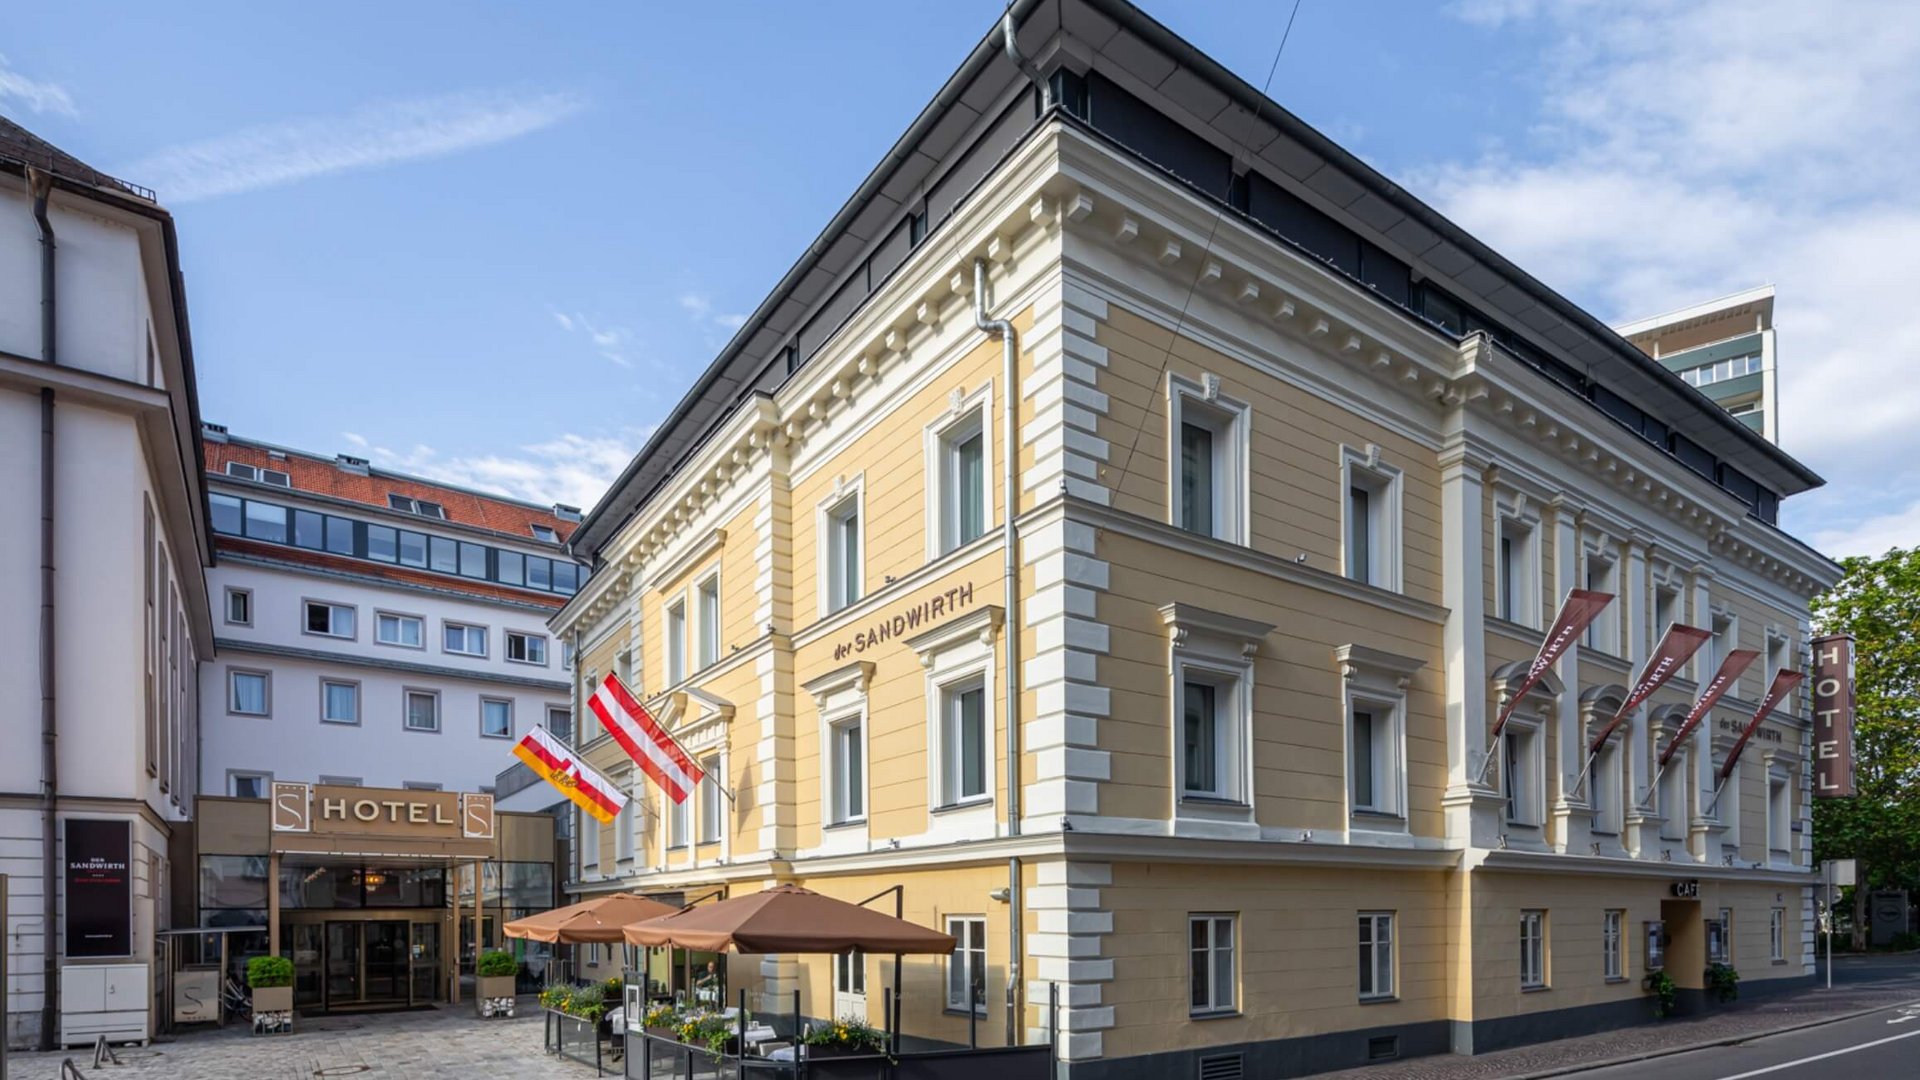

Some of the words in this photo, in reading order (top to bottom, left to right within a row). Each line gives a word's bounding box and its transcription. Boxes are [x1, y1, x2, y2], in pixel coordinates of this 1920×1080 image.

[834, 643, 852, 661] der
[855, 581, 973, 652] SANDWIRTH
[1816, 646, 1841, 790] HOTEL
[323, 797, 454, 824] HOTEL
[70, 862, 125, 870] SANDWIRTH
